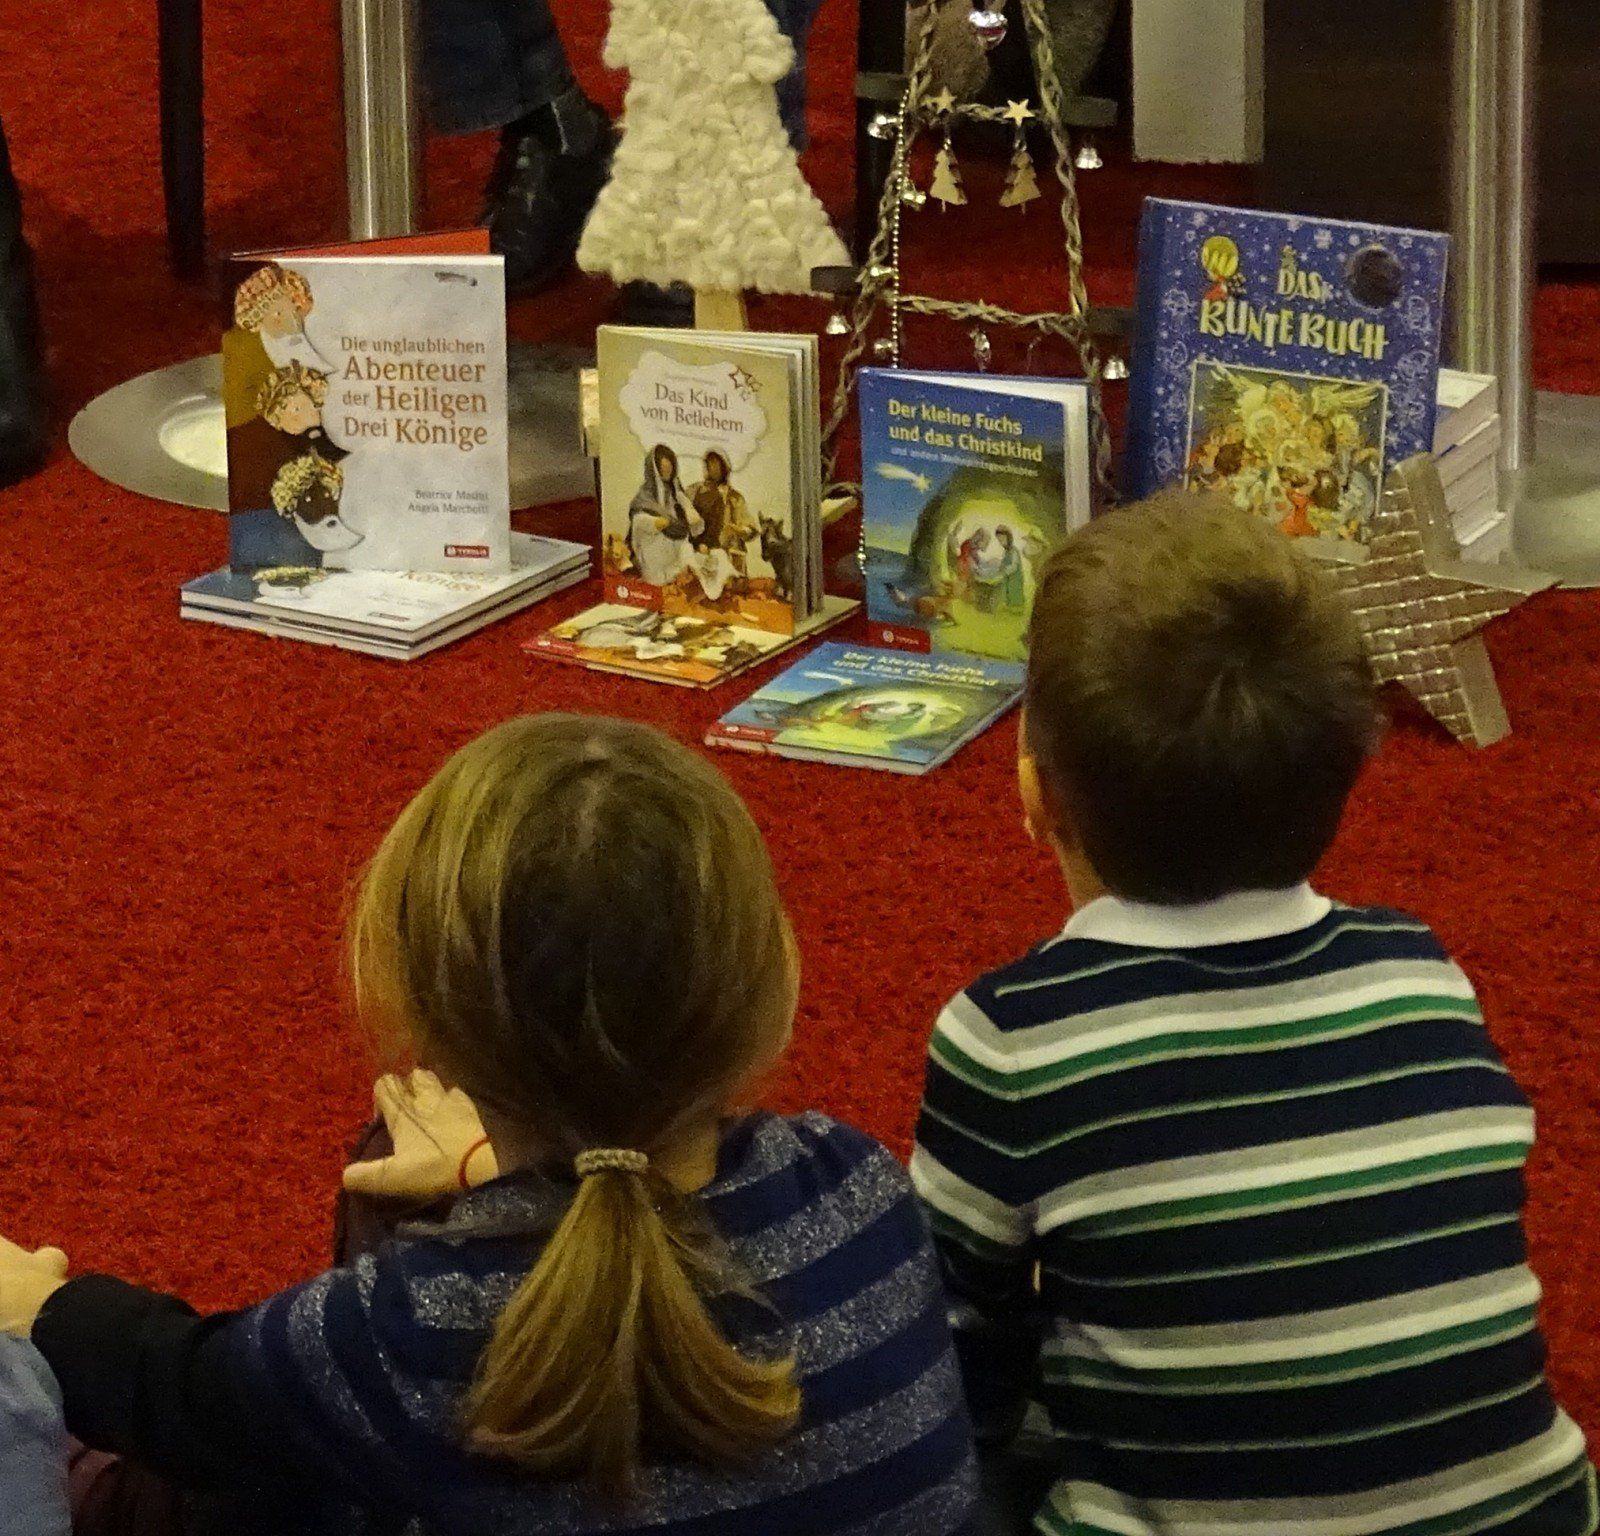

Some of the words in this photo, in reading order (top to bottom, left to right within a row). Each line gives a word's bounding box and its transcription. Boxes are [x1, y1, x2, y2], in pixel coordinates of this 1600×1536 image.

[1277, 267, 1323, 301] DAS
[1200, 297, 1294, 348] BUNTE
[1299, 312, 1389, 360] BUCH
[341, 336, 368, 352] Die
[372, 337, 486, 355] unglaublichen
[342, 355, 486, 382] Abenteuer
[342, 391, 369, 406] der
[375, 385, 487, 418] Heiligen
[655, 382, 684, 404] Das
[690, 388, 728, 410] Kind
[640, 405, 669, 421] von
[674, 406, 744, 433] Betlehem
[888, 399, 917, 418] Der
[921, 403, 972, 427] kleine
[975, 413, 1023, 435] Fuchs
[344, 417, 388, 437] Drei
[394, 417, 488, 451] Könige
[889, 425, 920, 442] und
[925, 428, 954, 447] das
[958, 433, 1043, 462] Christkind
